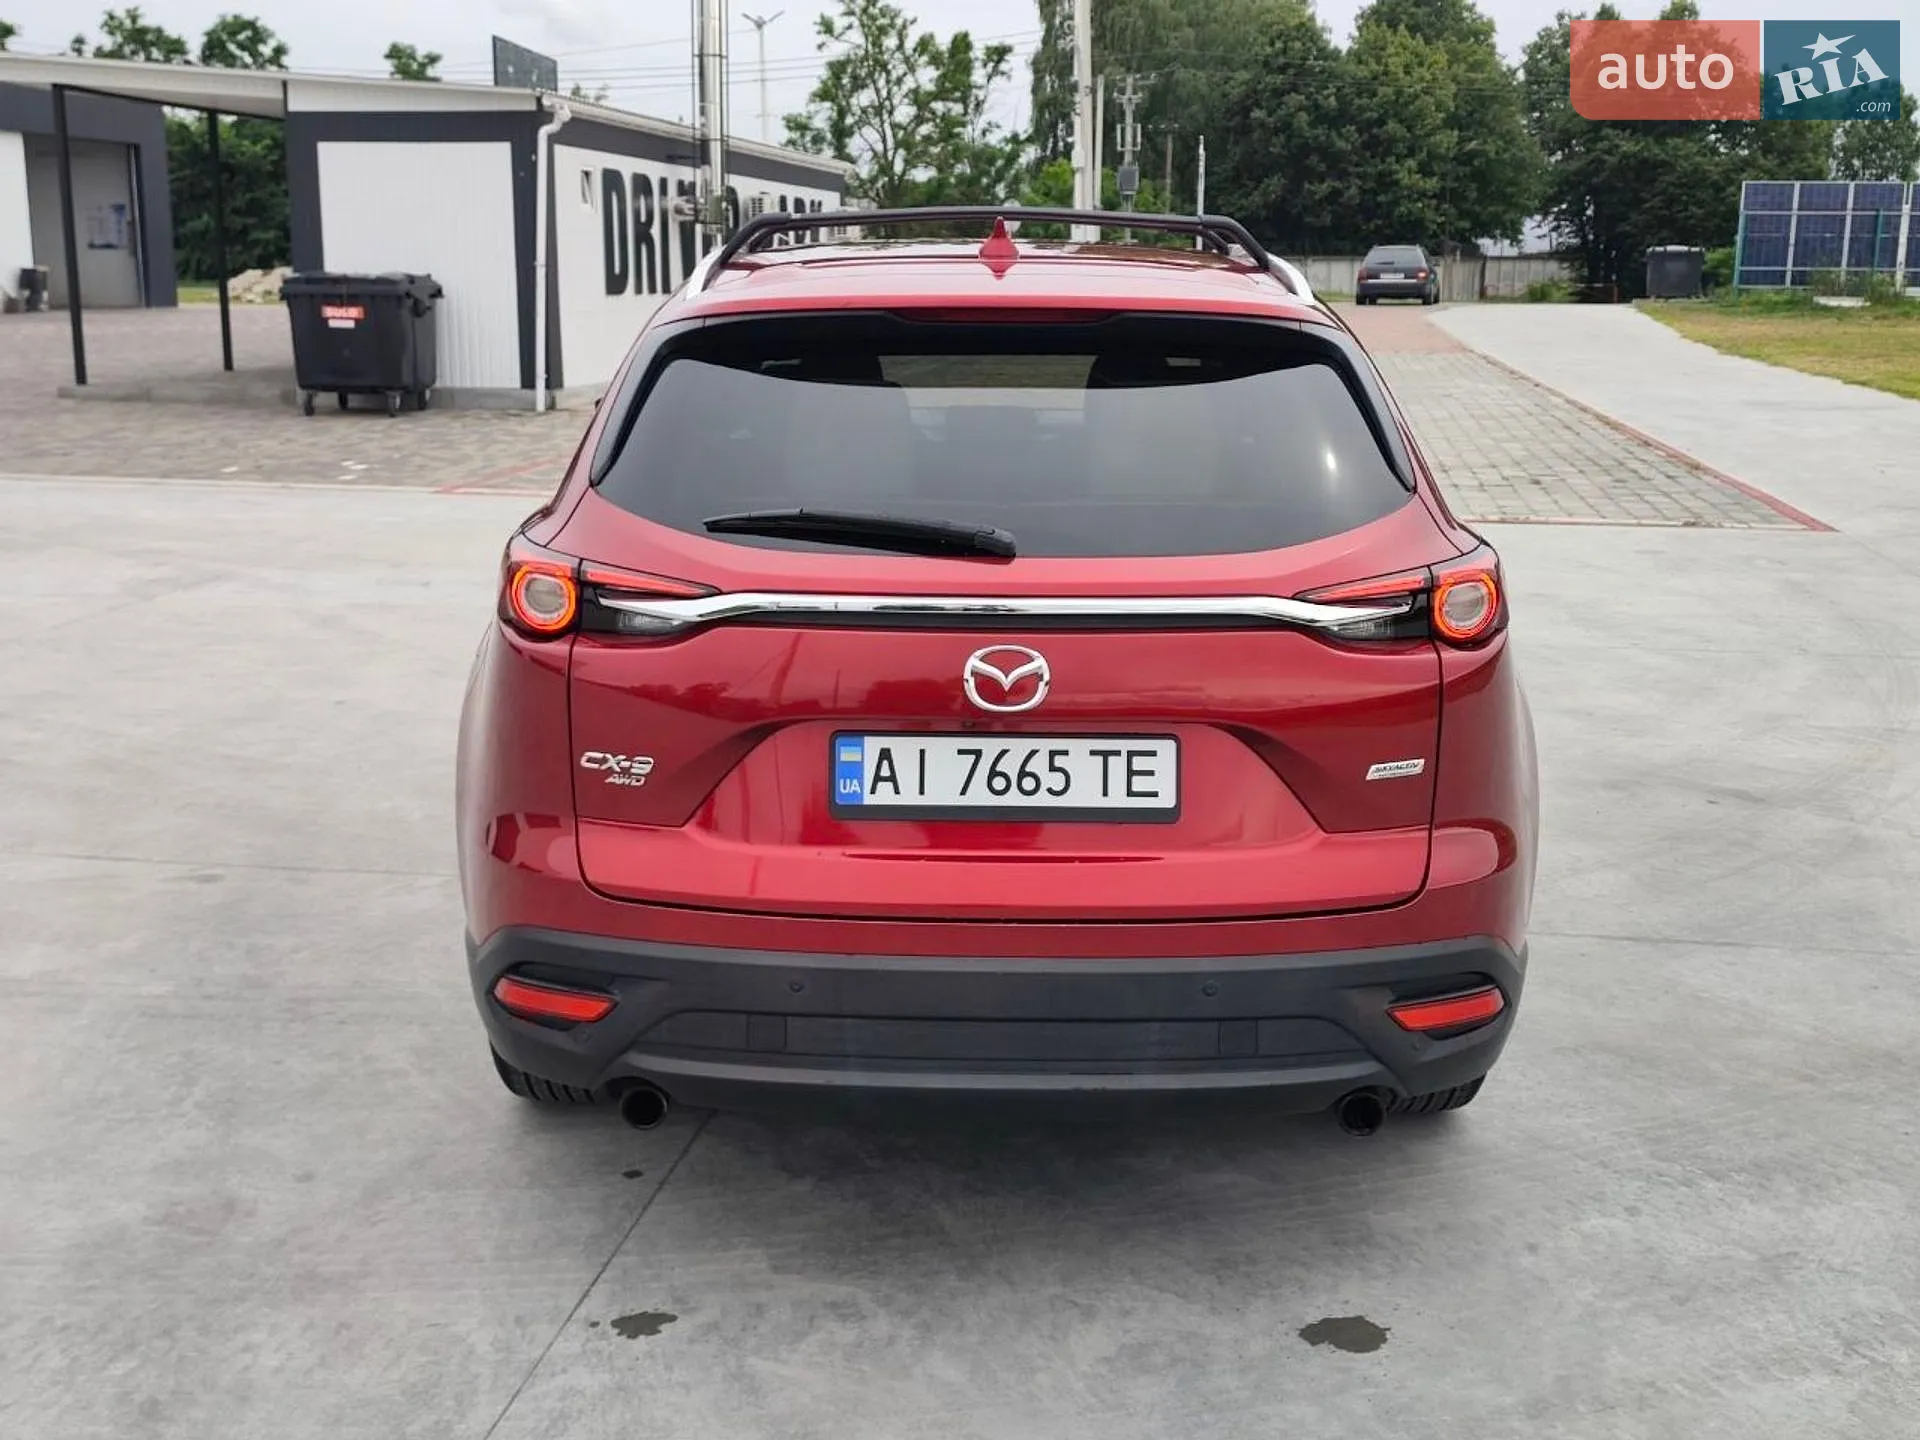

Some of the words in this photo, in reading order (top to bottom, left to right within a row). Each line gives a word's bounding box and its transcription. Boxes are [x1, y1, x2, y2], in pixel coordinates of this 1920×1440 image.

[580, 751, 654, 775] CX-9
[869, 747, 925, 796] AI
[957, 749, 1071, 797] 7665
[1089, 750, 1159, 798] TE
[604, 773, 645, 786] AWD
[839, 778, 861, 793] UA
